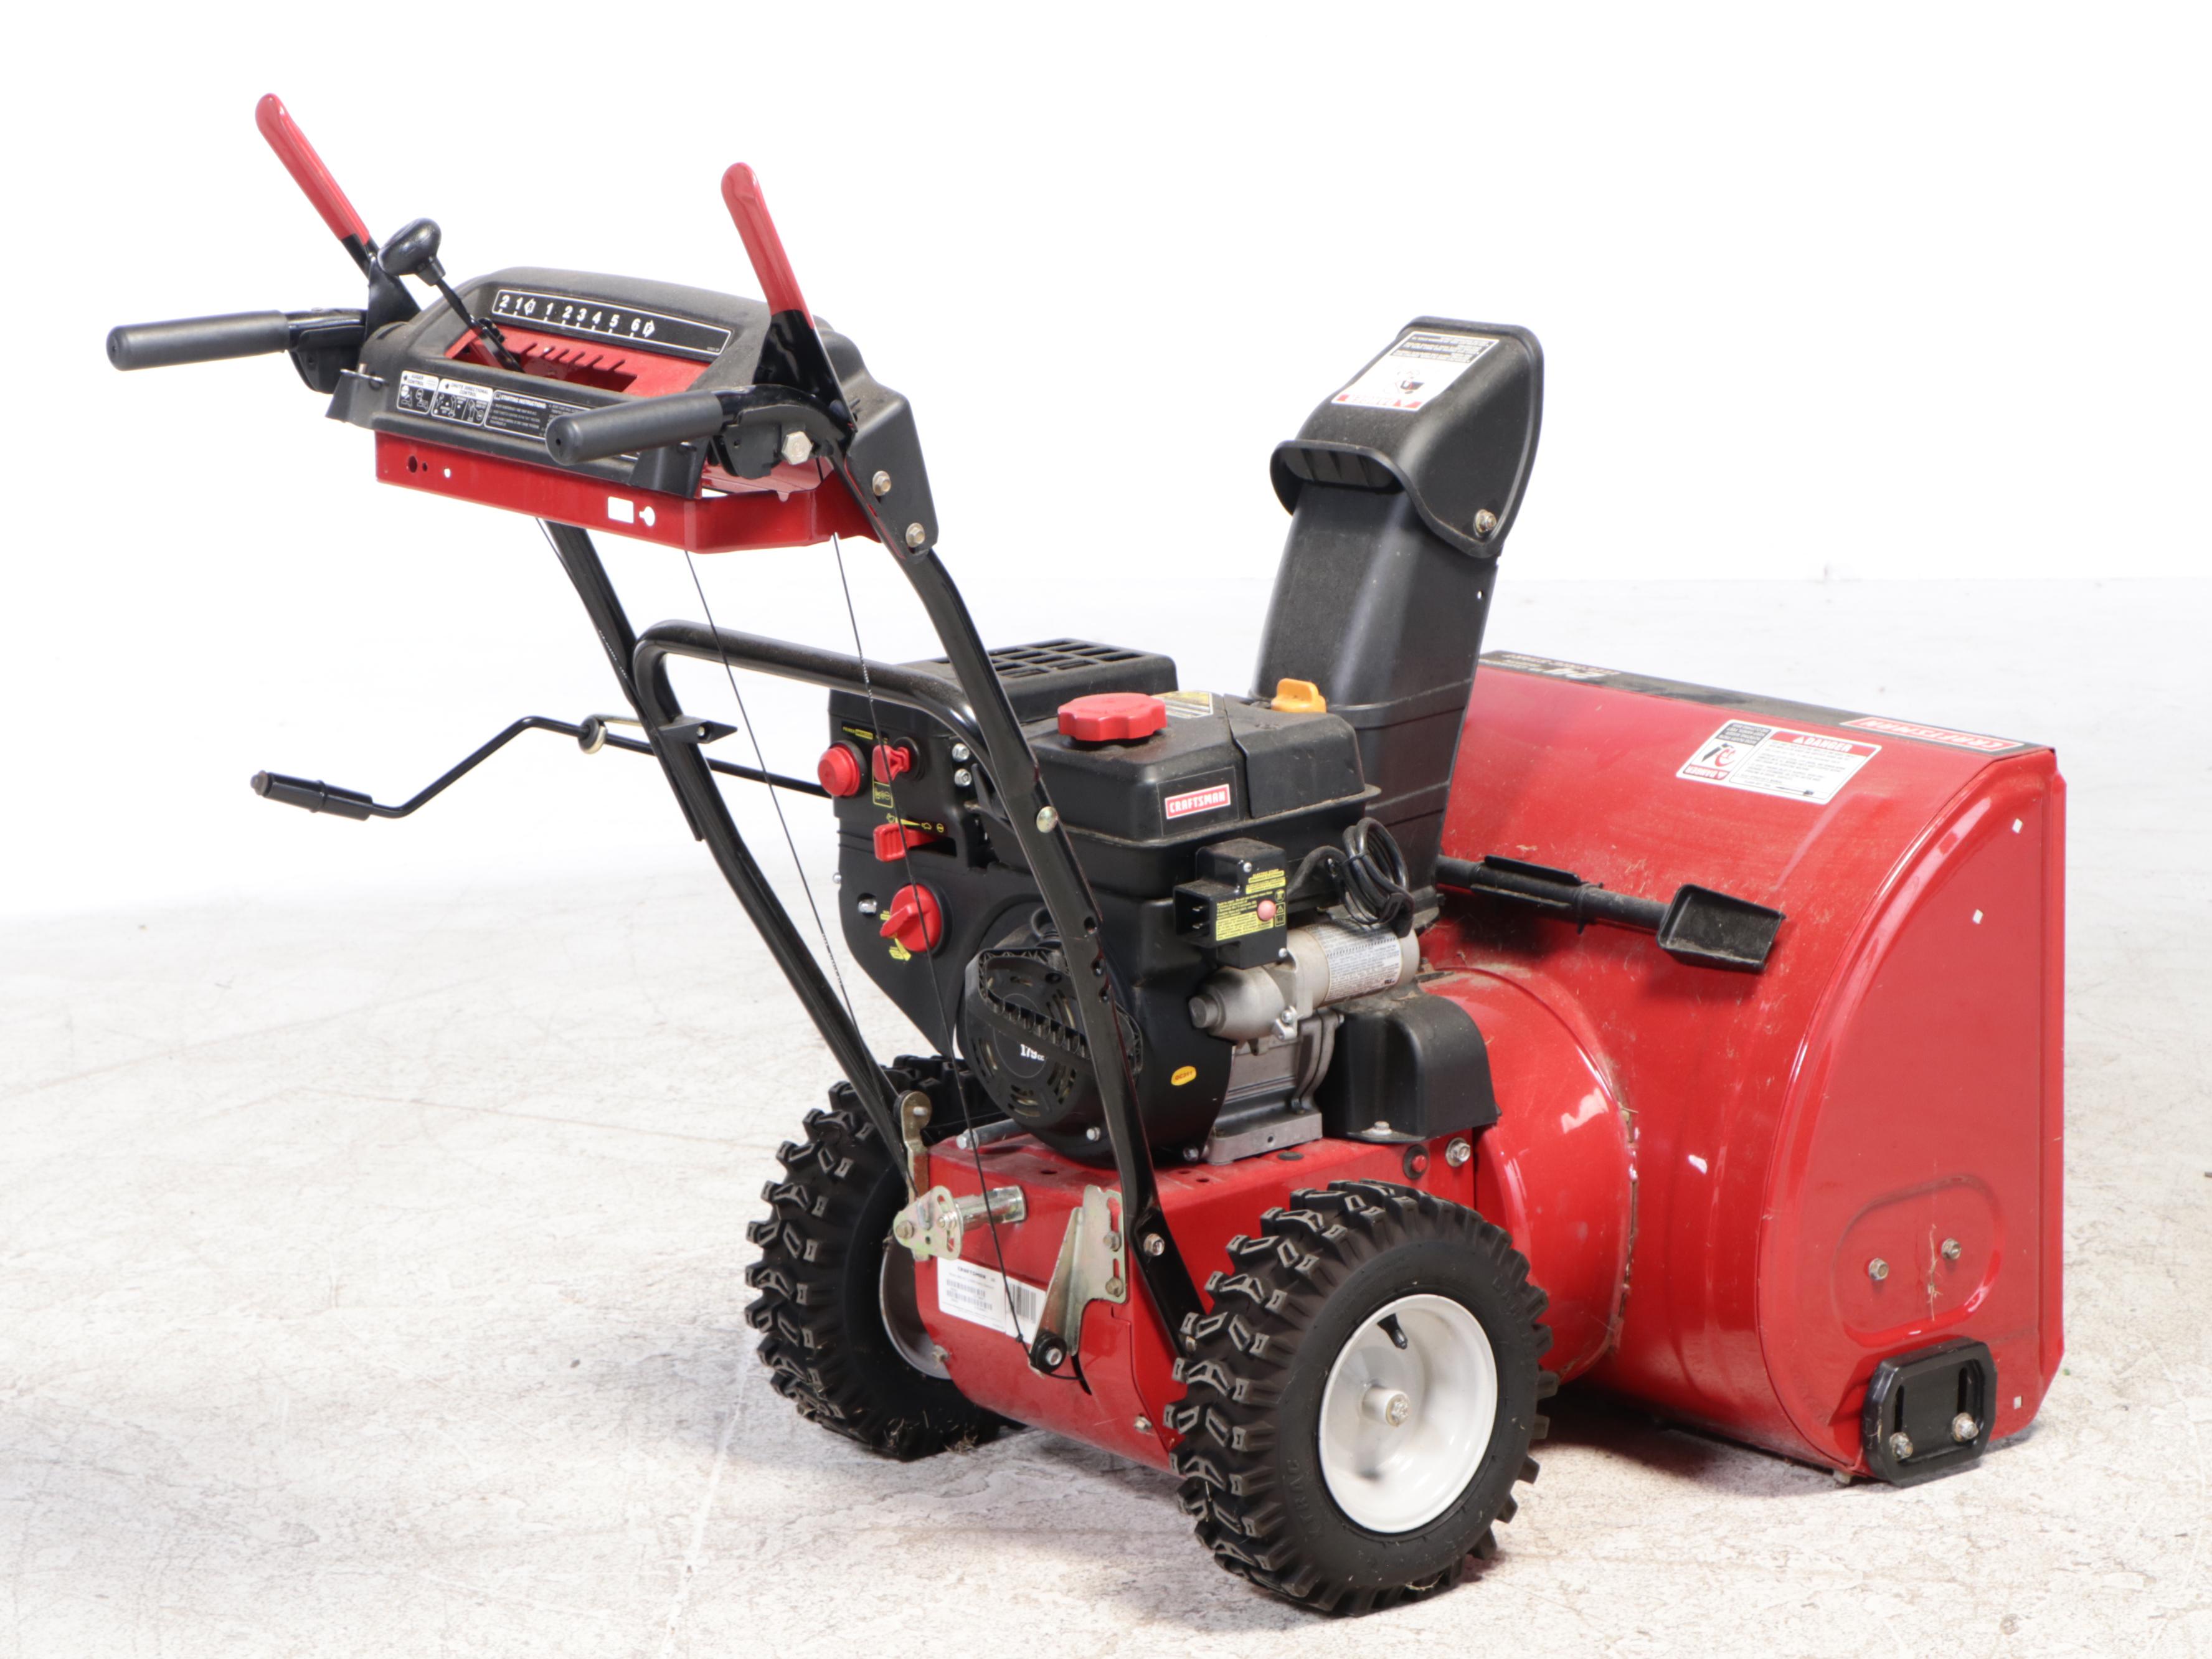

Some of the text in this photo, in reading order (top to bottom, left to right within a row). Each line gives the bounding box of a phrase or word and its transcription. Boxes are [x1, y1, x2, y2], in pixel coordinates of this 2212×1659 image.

[499, 295, 510, 308] 2
[515, 297, 524, 310] 1
[546, 302, 554, 316] 1
[562, 305, 573, 319] 2
[577, 308, 587, 321] 3
[592, 311, 602, 324] 4
[609, 314, 620, 328] 5
[631, 318, 641, 331] 6
[1803, 736, 1853, 753] DANGER
[1860, 719, 2004, 749] CRAFTSMAN
[1169, 790, 1226, 814] CRAFTSMAN
